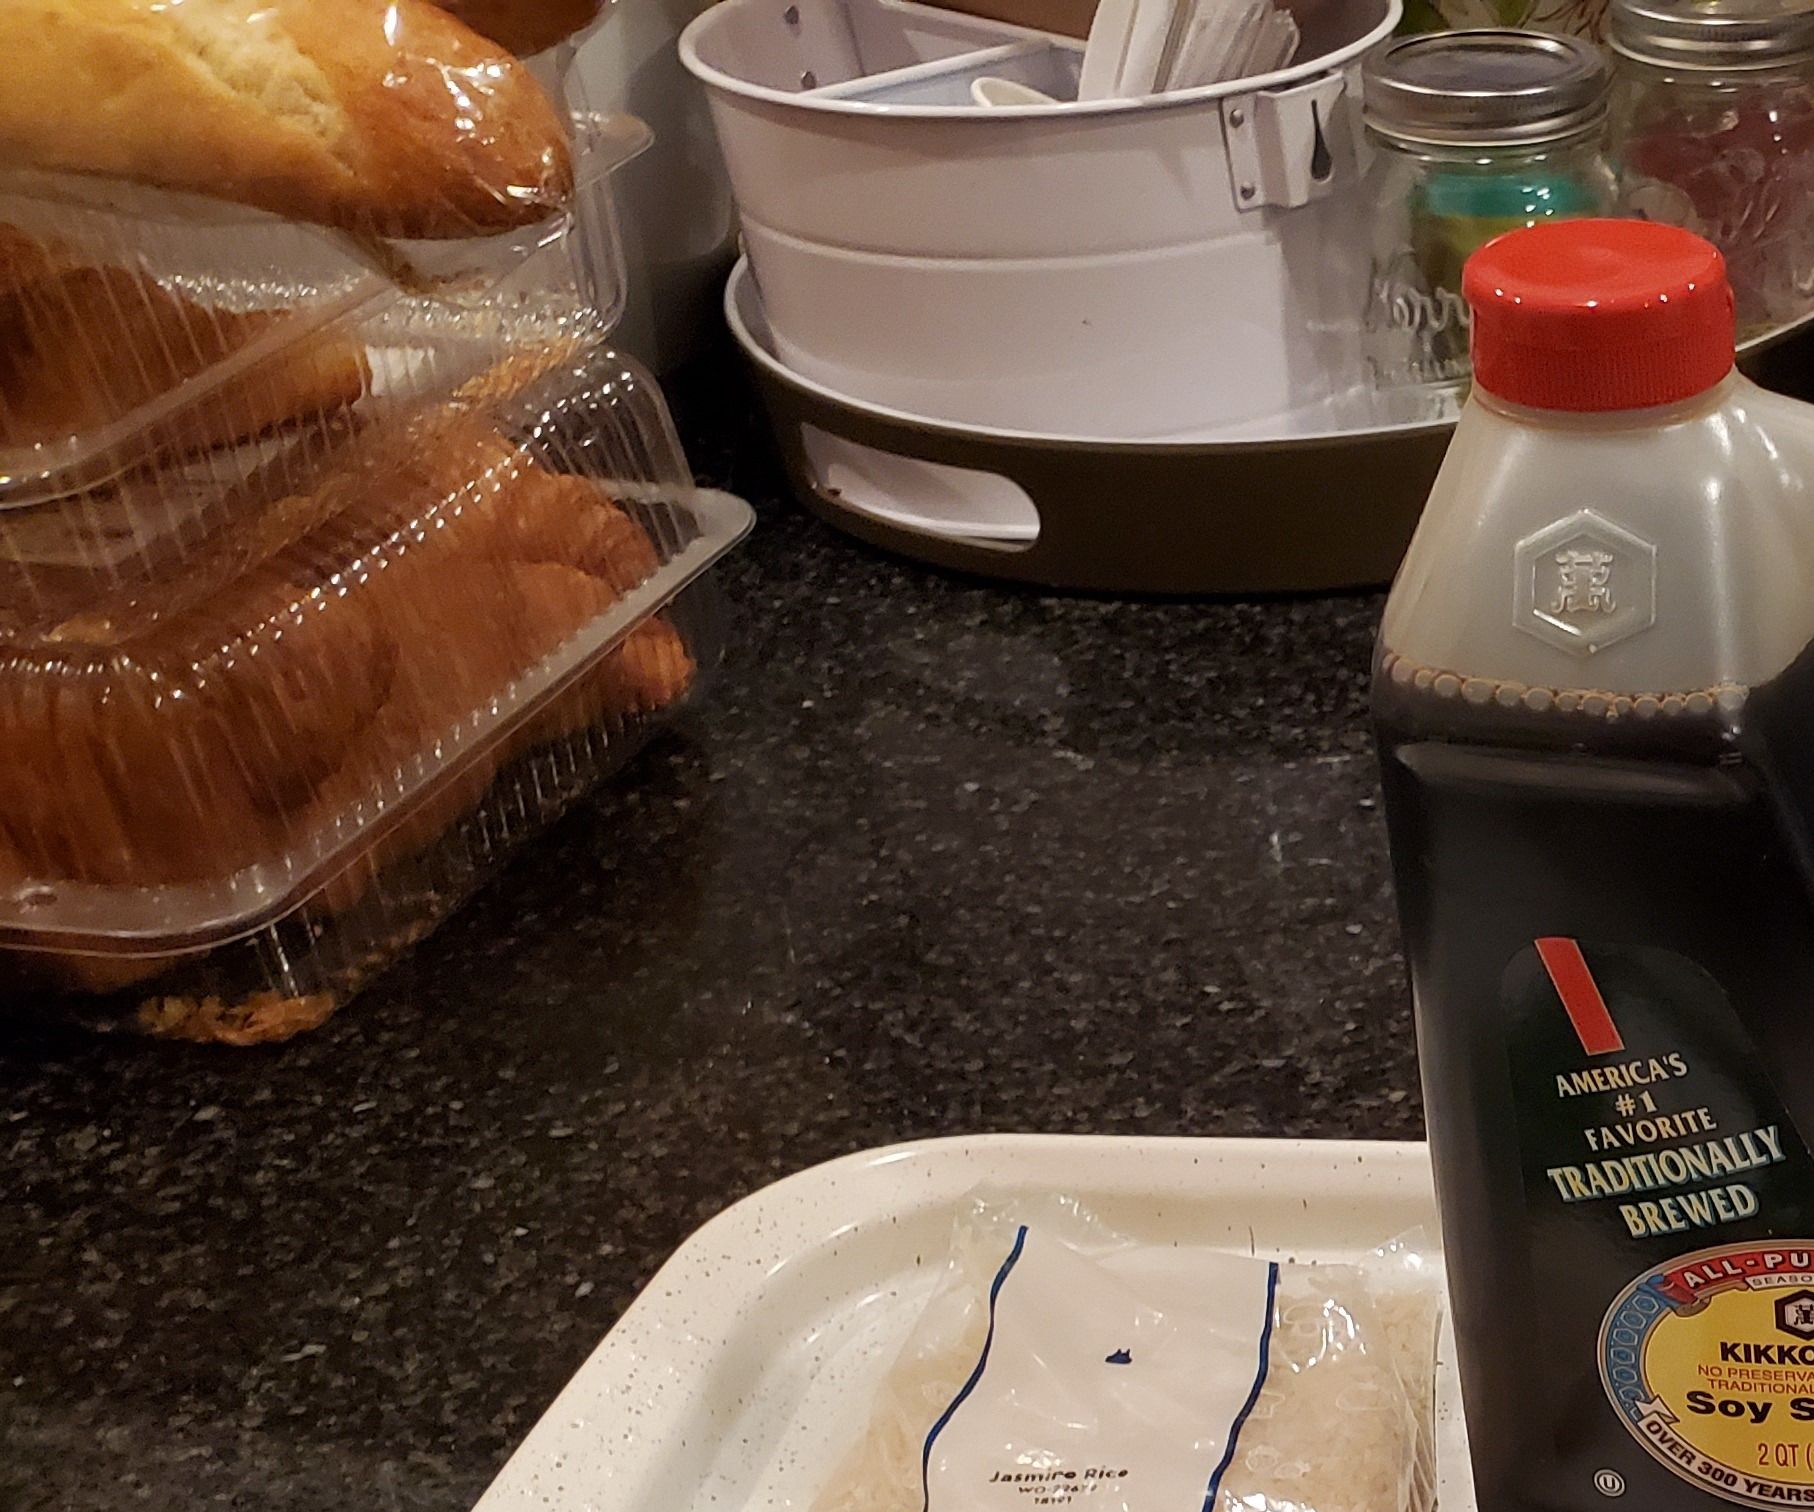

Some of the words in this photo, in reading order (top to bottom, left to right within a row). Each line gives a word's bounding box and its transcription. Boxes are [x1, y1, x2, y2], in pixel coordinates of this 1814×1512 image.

[1555, 1053, 1688, 1097] AMERICA'S
[1584, 1107, 1717, 1151] FAVORITE
[1547, 1125, 1786, 1202] TRADITIONALLY
[1619, 1184, 1759, 1238] BREWED
[1698, 1365, 1723, 1378] NO
[1686, 1391, 1773, 1423] Soy
[1646, 1419, 1694, 1466] OVER
[1697, 1459, 1738, 1489] 300
[1757, 1442, 1769, 1467] 2
[1774, 1442, 1799, 1469] QT
